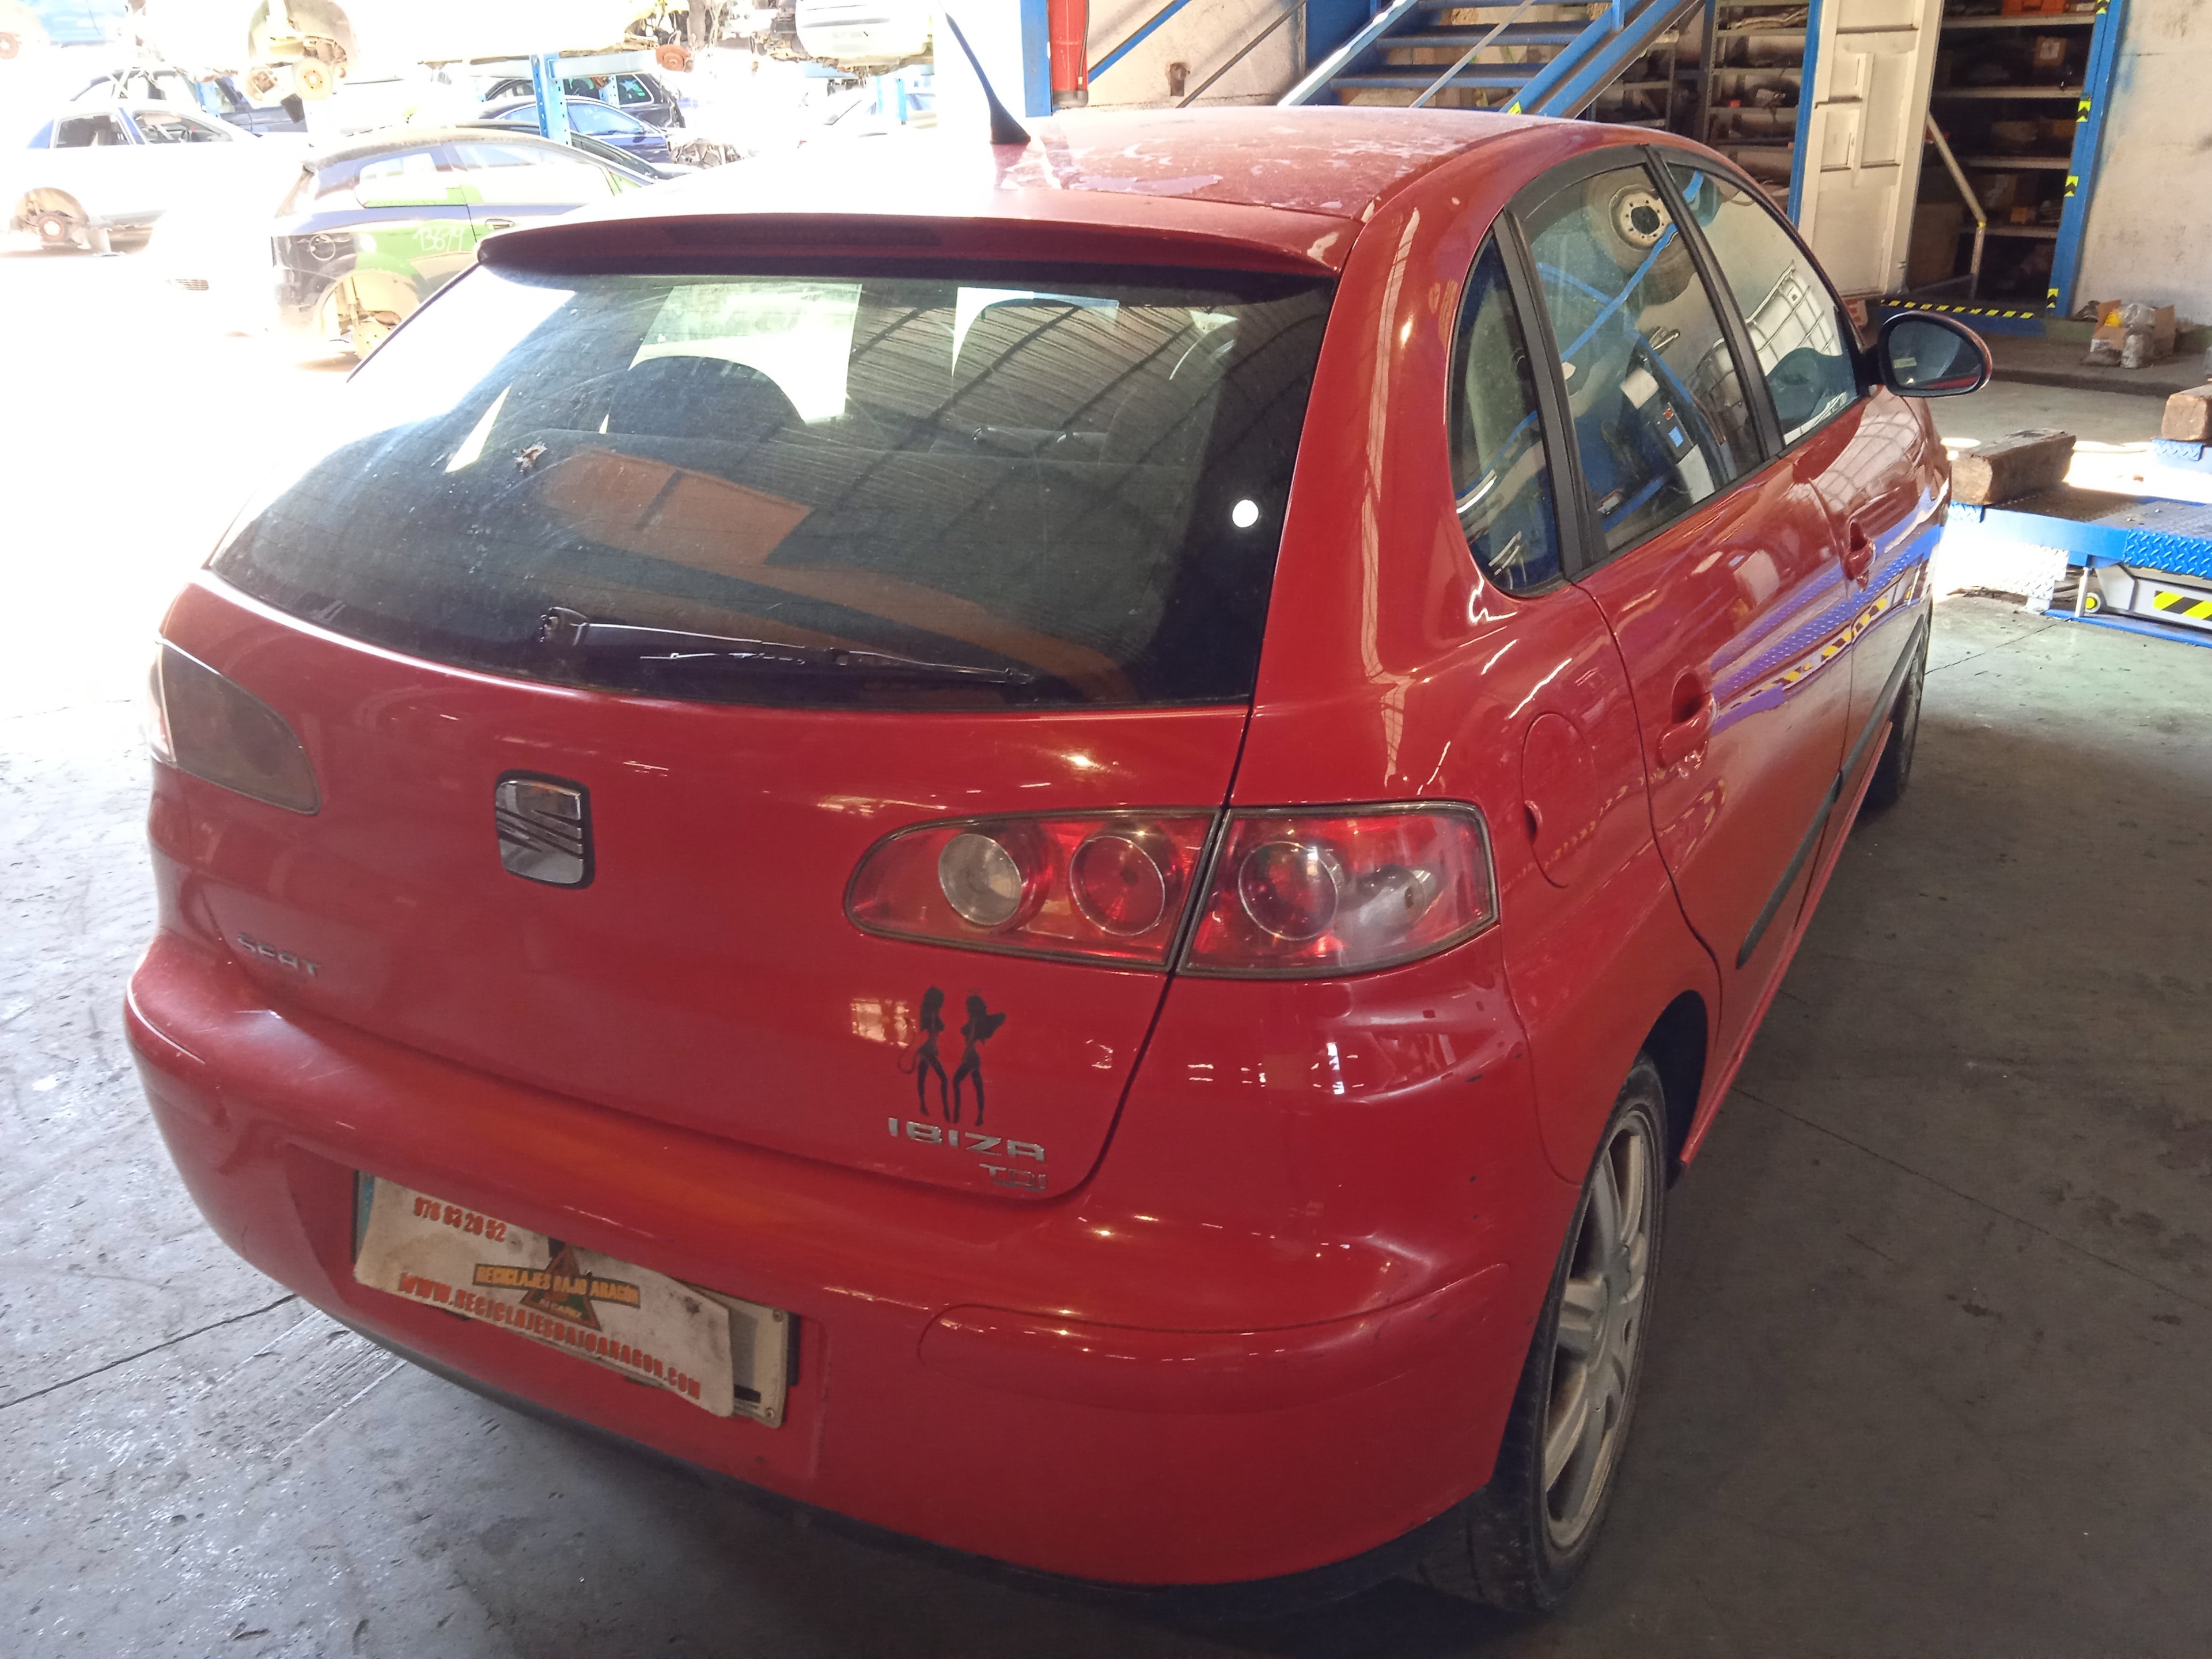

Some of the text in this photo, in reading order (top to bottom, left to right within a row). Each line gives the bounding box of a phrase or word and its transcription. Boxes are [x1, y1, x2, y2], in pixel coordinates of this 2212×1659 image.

[238, 932, 321, 977] SEAT
[888, 1118, 1045, 1161] IBIZA
[486, 1218, 506, 1243] 52
